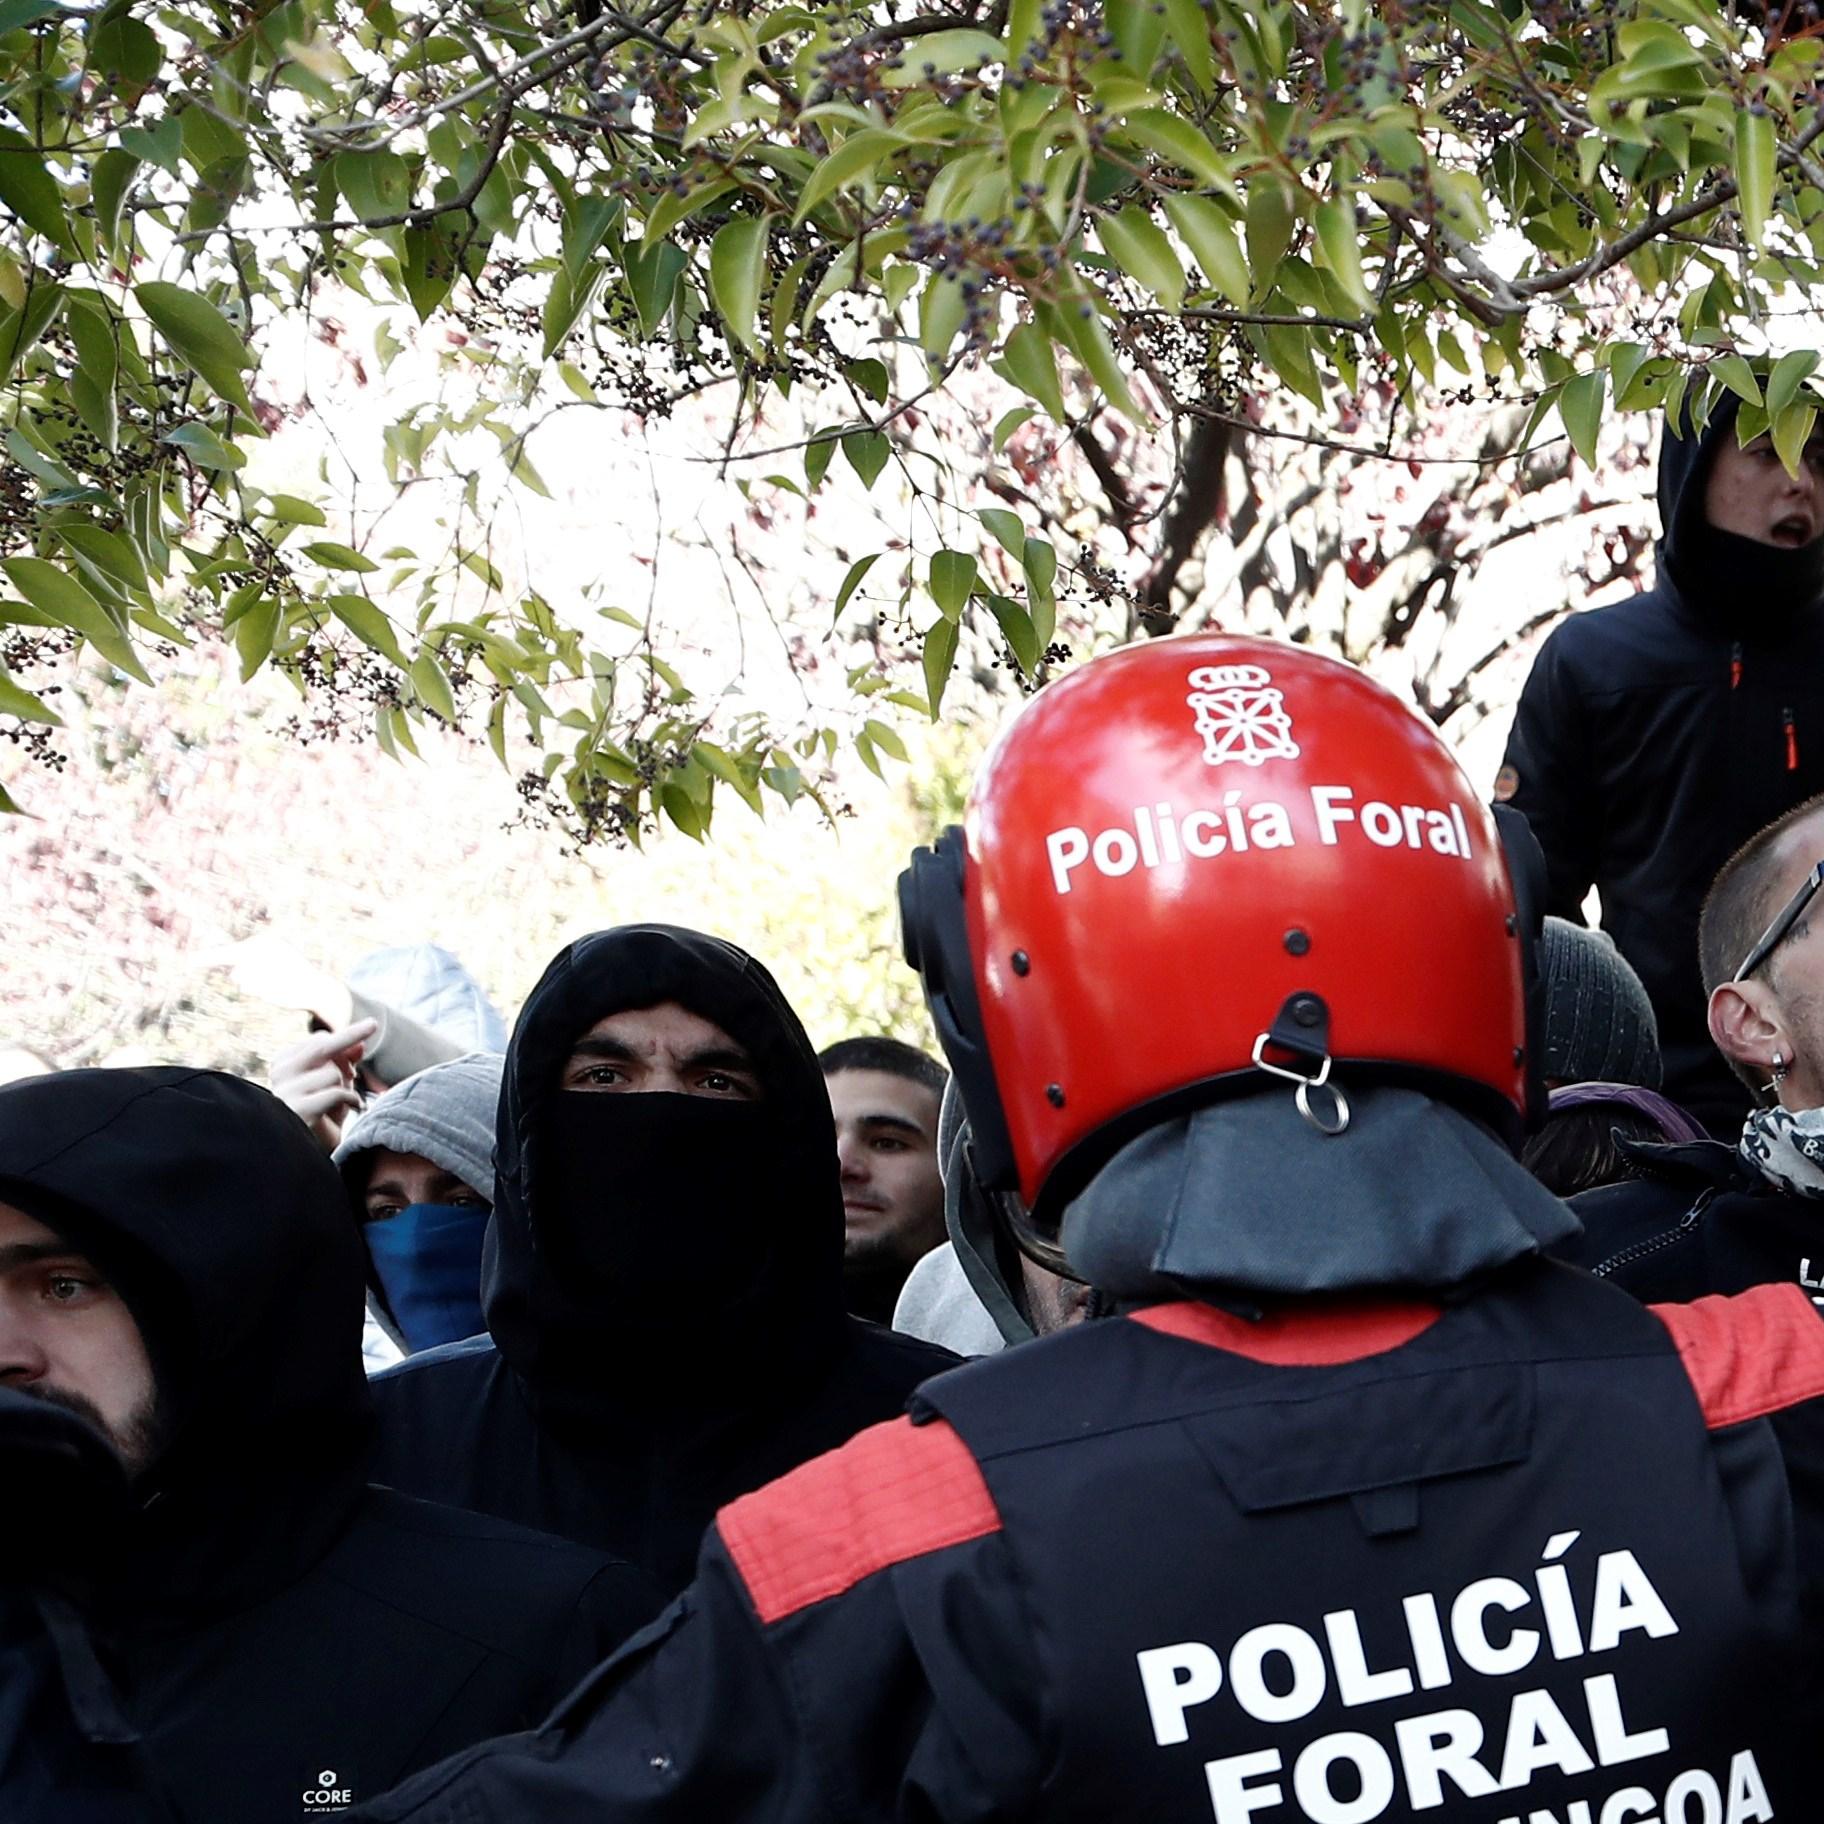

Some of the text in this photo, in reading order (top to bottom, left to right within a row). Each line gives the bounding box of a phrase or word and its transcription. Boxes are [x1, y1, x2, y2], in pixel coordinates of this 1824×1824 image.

[1045, 785, 1473, 894] Policía Foral
[1137, 1530, 1680, 1746] POLICÍA
[302, 1789, 352, 1804] CORE
